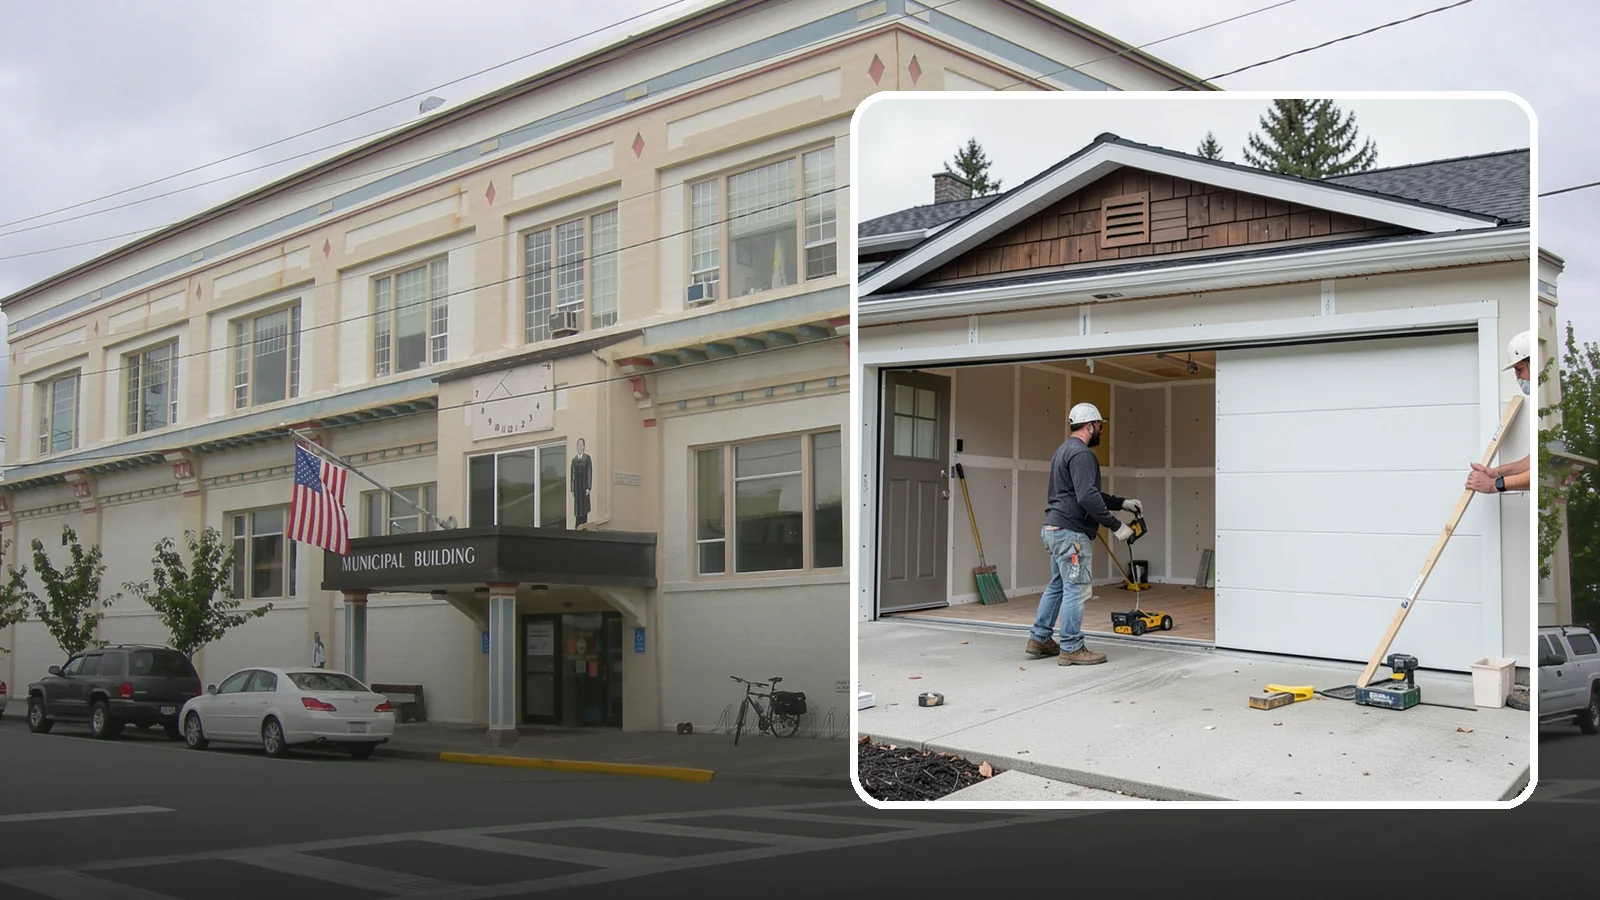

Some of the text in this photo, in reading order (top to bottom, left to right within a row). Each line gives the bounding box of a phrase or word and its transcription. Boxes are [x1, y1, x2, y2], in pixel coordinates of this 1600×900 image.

[546, 362, 551, 370] 6
[536, 402, 540, 410] 4
[481, 407, 485, 415] 8
[488, 417, 492, 426] 9
[529, 414, 533, 422] 3
[494, 424, 500, 432] 10
[521, 420, 525, 428] 2
[342, 546, 475, 572] MUNICIPAL BUILDING
